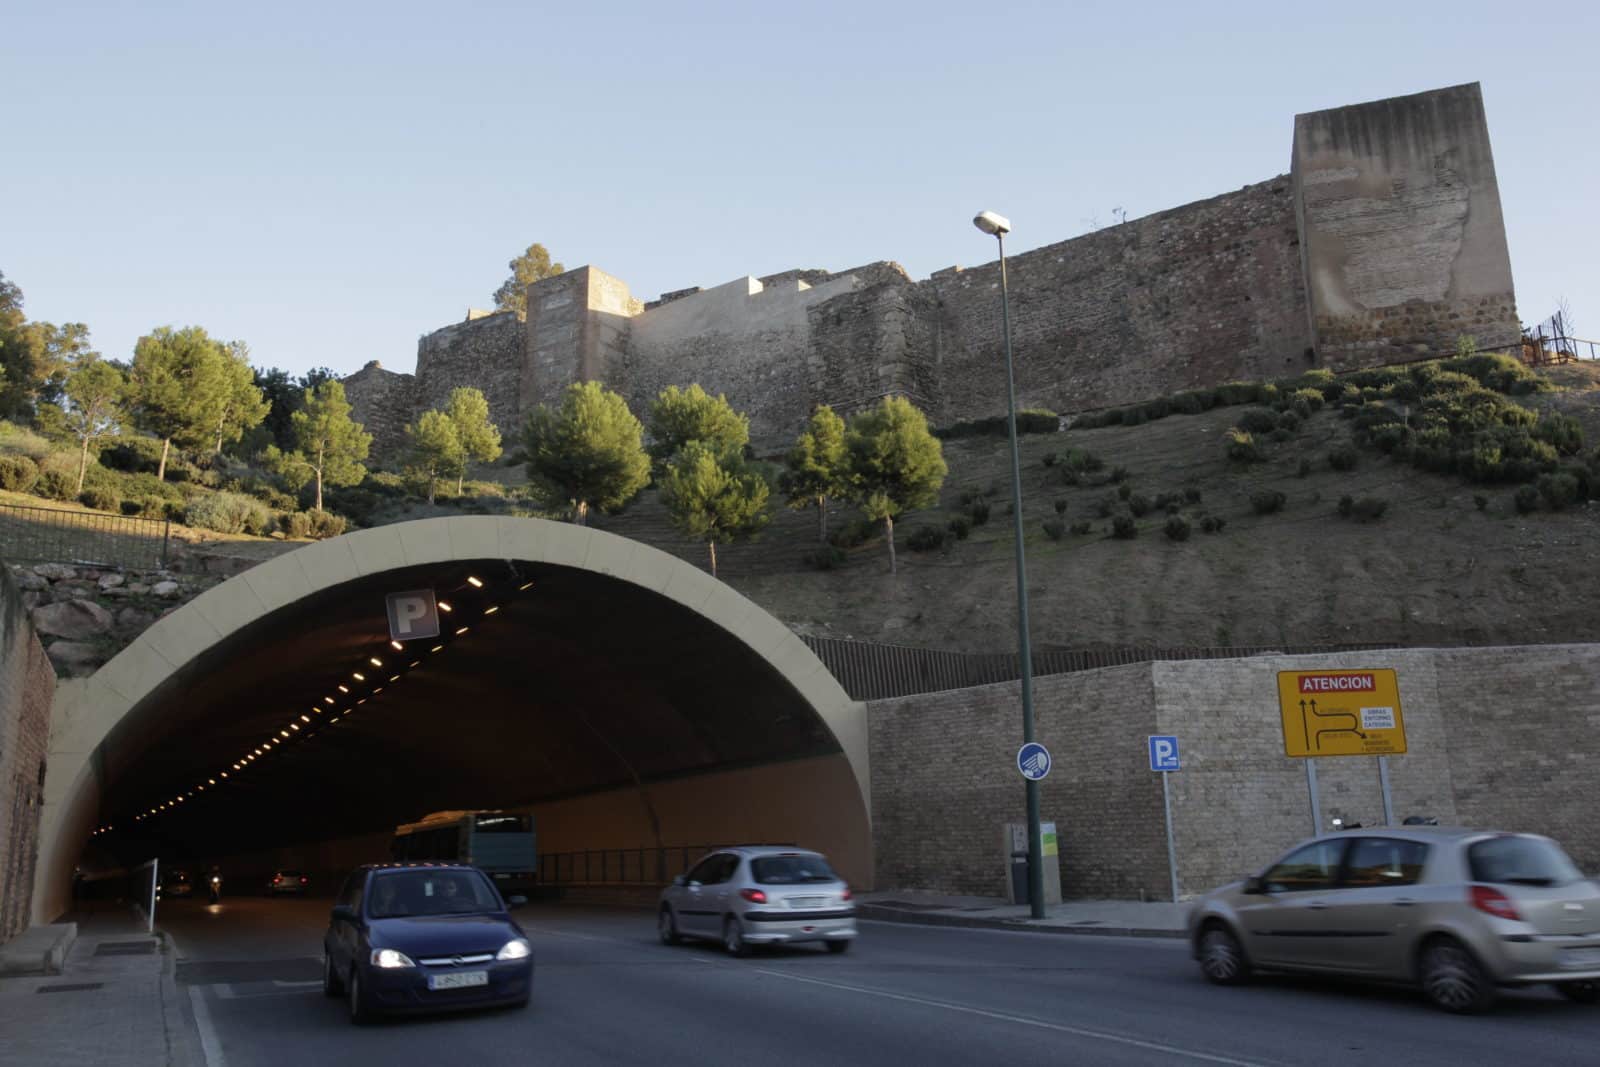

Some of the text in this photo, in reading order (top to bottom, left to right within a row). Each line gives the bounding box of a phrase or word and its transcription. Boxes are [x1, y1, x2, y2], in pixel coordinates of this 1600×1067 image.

[396, 598, 426, 633] P
[1303, 676, 1372, 690] ATENCION
[1155, 740, 1172, 767] P
